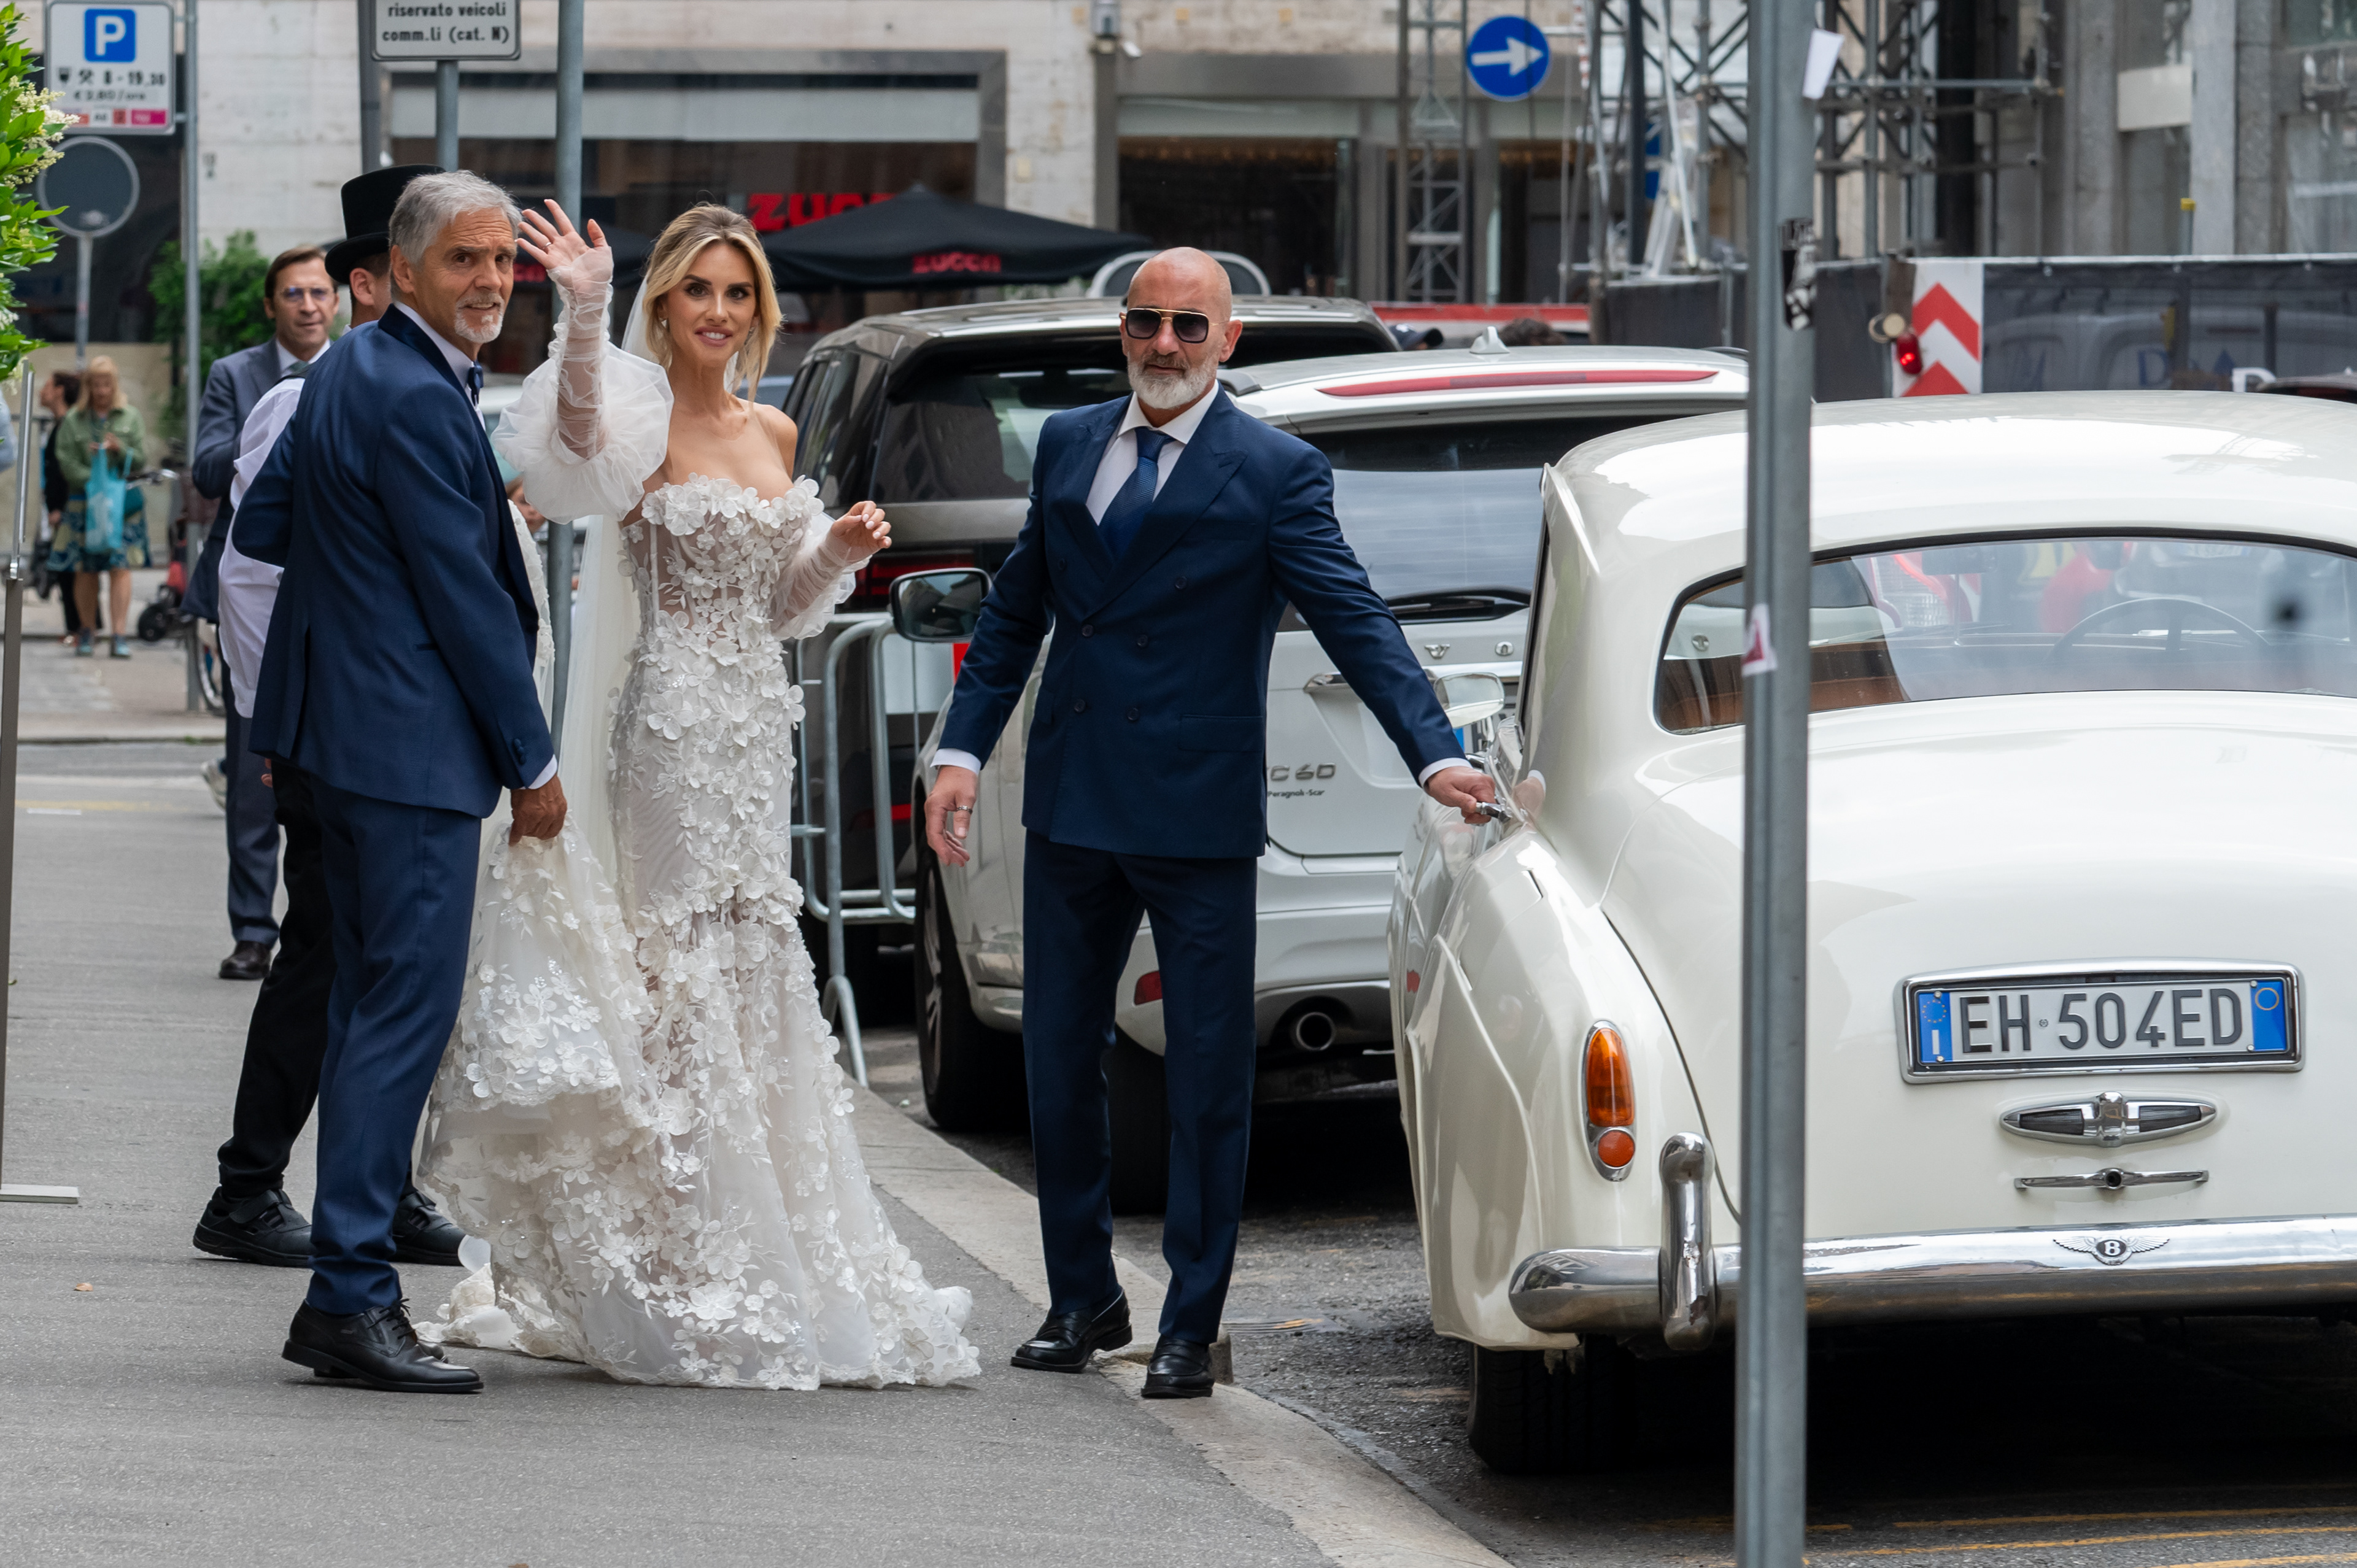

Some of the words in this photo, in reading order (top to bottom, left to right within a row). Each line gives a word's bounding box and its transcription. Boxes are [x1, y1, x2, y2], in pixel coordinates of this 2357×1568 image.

[388, 3, 453, 17] riservato
[458, 2, 506, 16] veicoli
[95, 15, 126, 56] P
[382, 26, 441, 41] comm.li
[449, 26, 485, 44] (cat.
[1959, 994, 2032, 1054] EH
[2058, 988, 2243, 1050] 504ED
